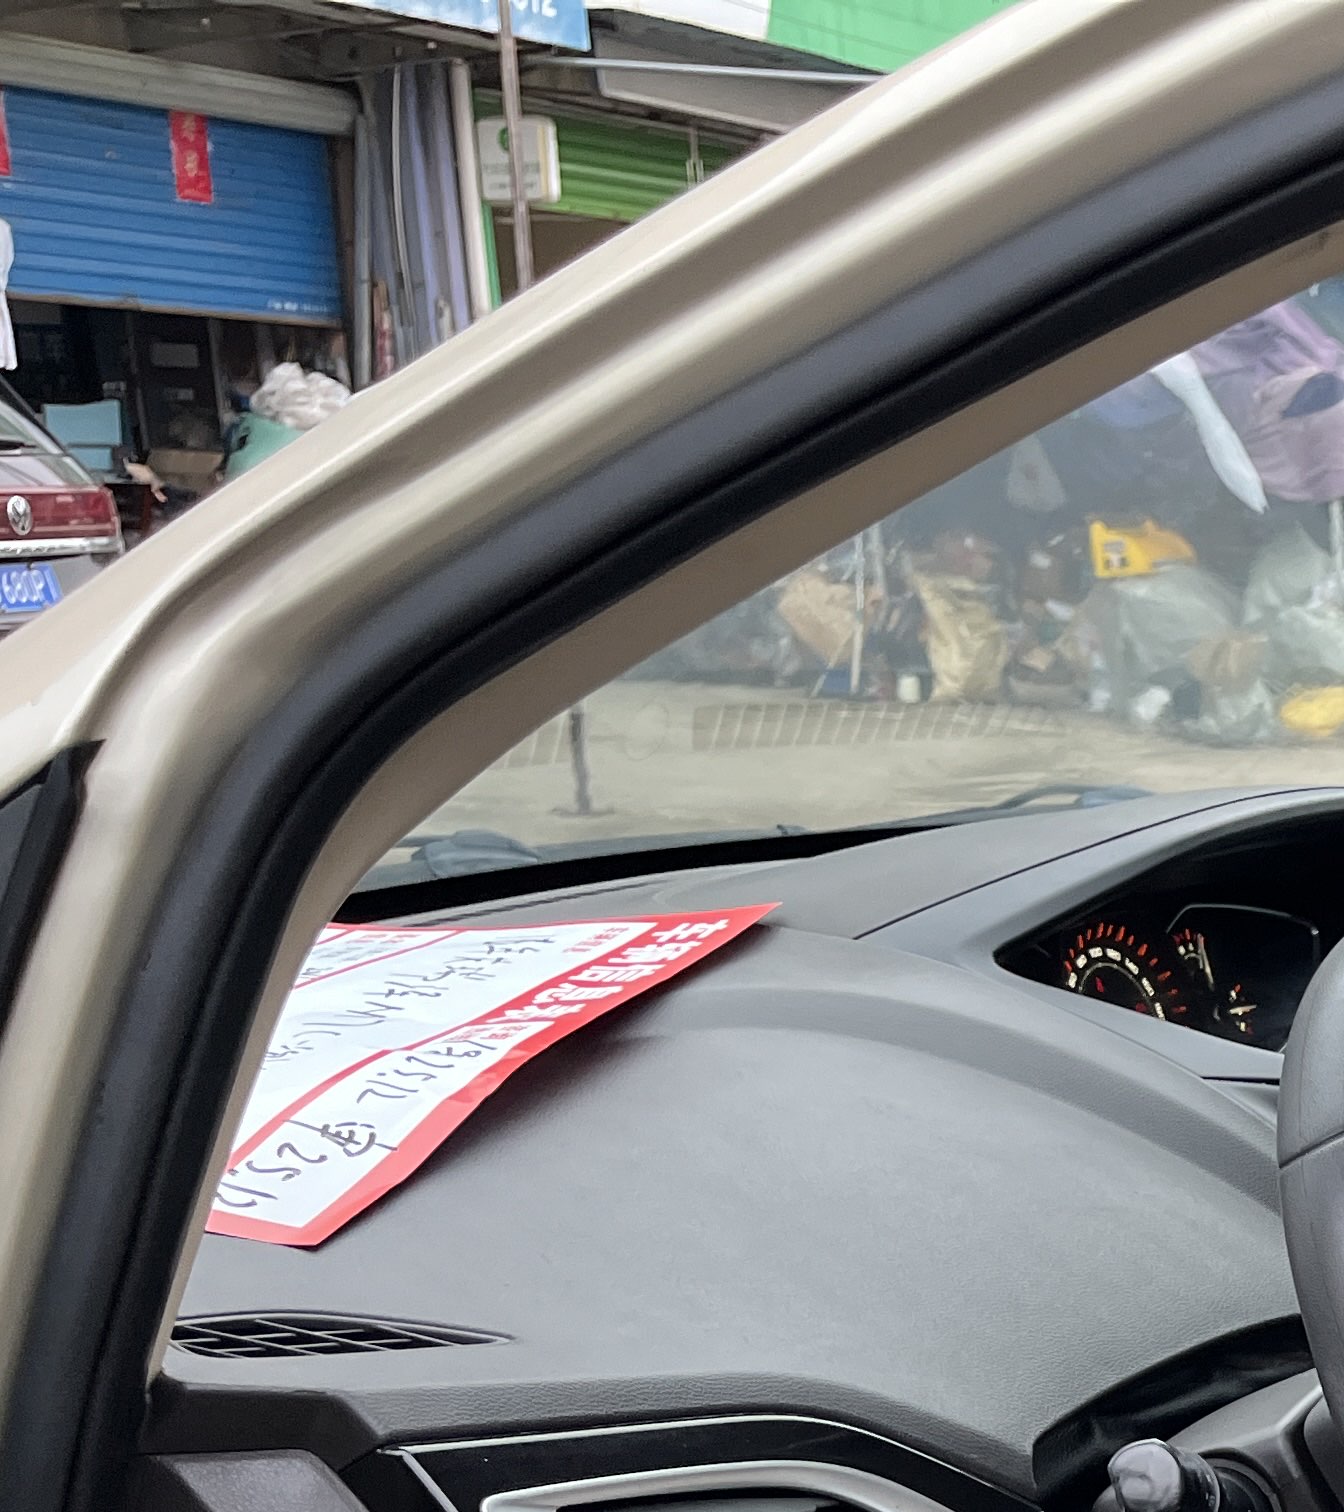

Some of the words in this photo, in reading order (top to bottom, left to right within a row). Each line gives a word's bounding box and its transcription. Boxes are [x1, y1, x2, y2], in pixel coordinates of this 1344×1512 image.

[485, 917, 731, 1024] 车辆信息表
